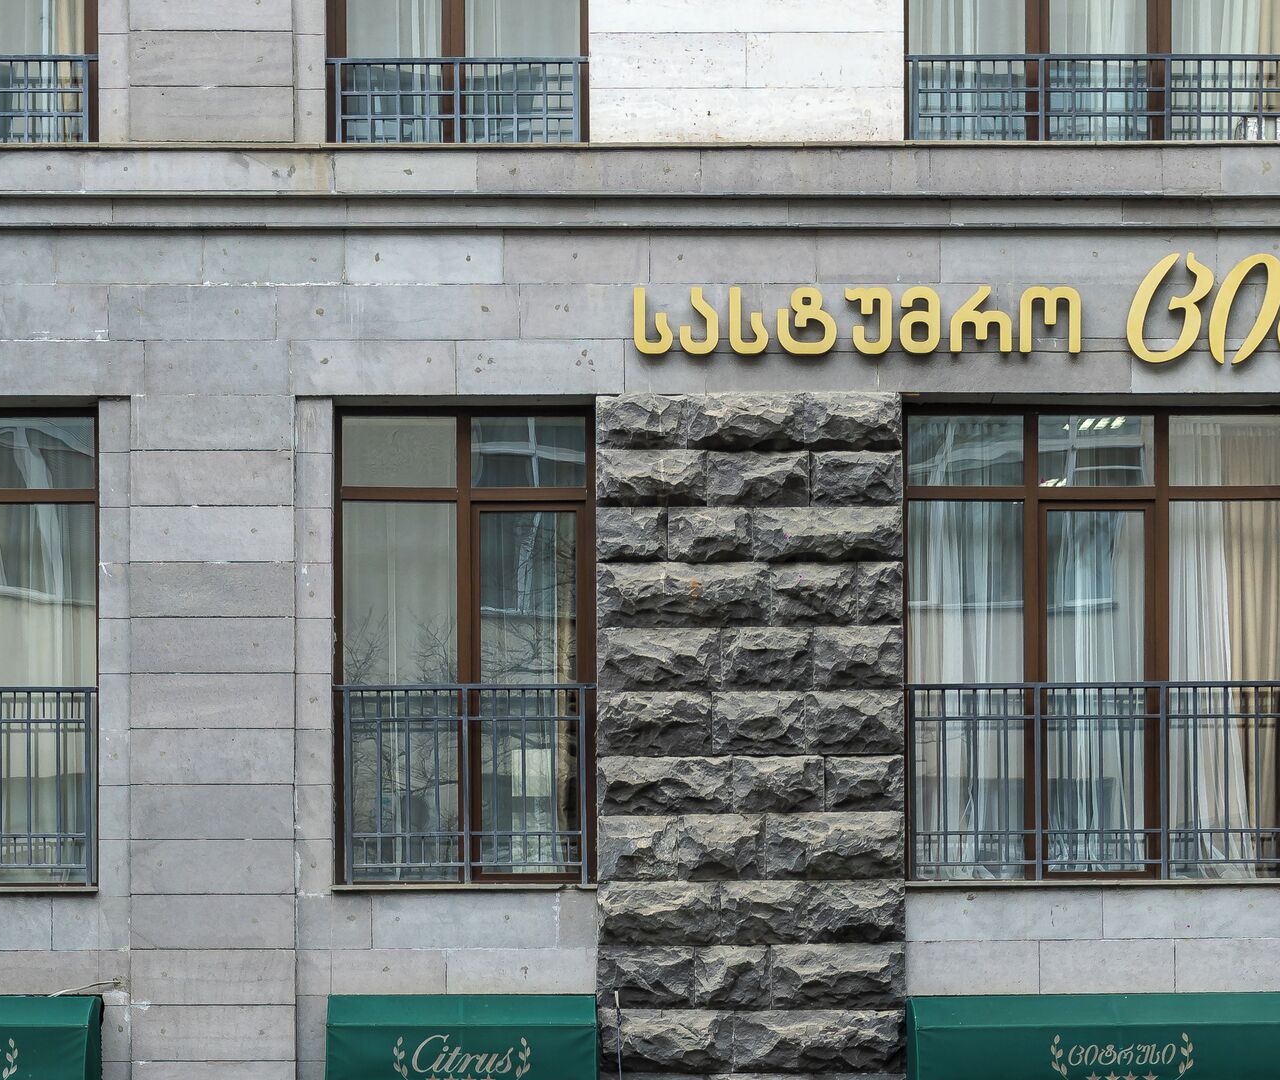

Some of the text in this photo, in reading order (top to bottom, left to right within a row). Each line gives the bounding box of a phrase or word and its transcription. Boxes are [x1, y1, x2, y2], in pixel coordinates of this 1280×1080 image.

[633, 284, 1082, 355] სასტუმრო
[411, 1034, 514, 1074] Citrus
[1068, 1043, 1177, 1066] ციტრუსი
